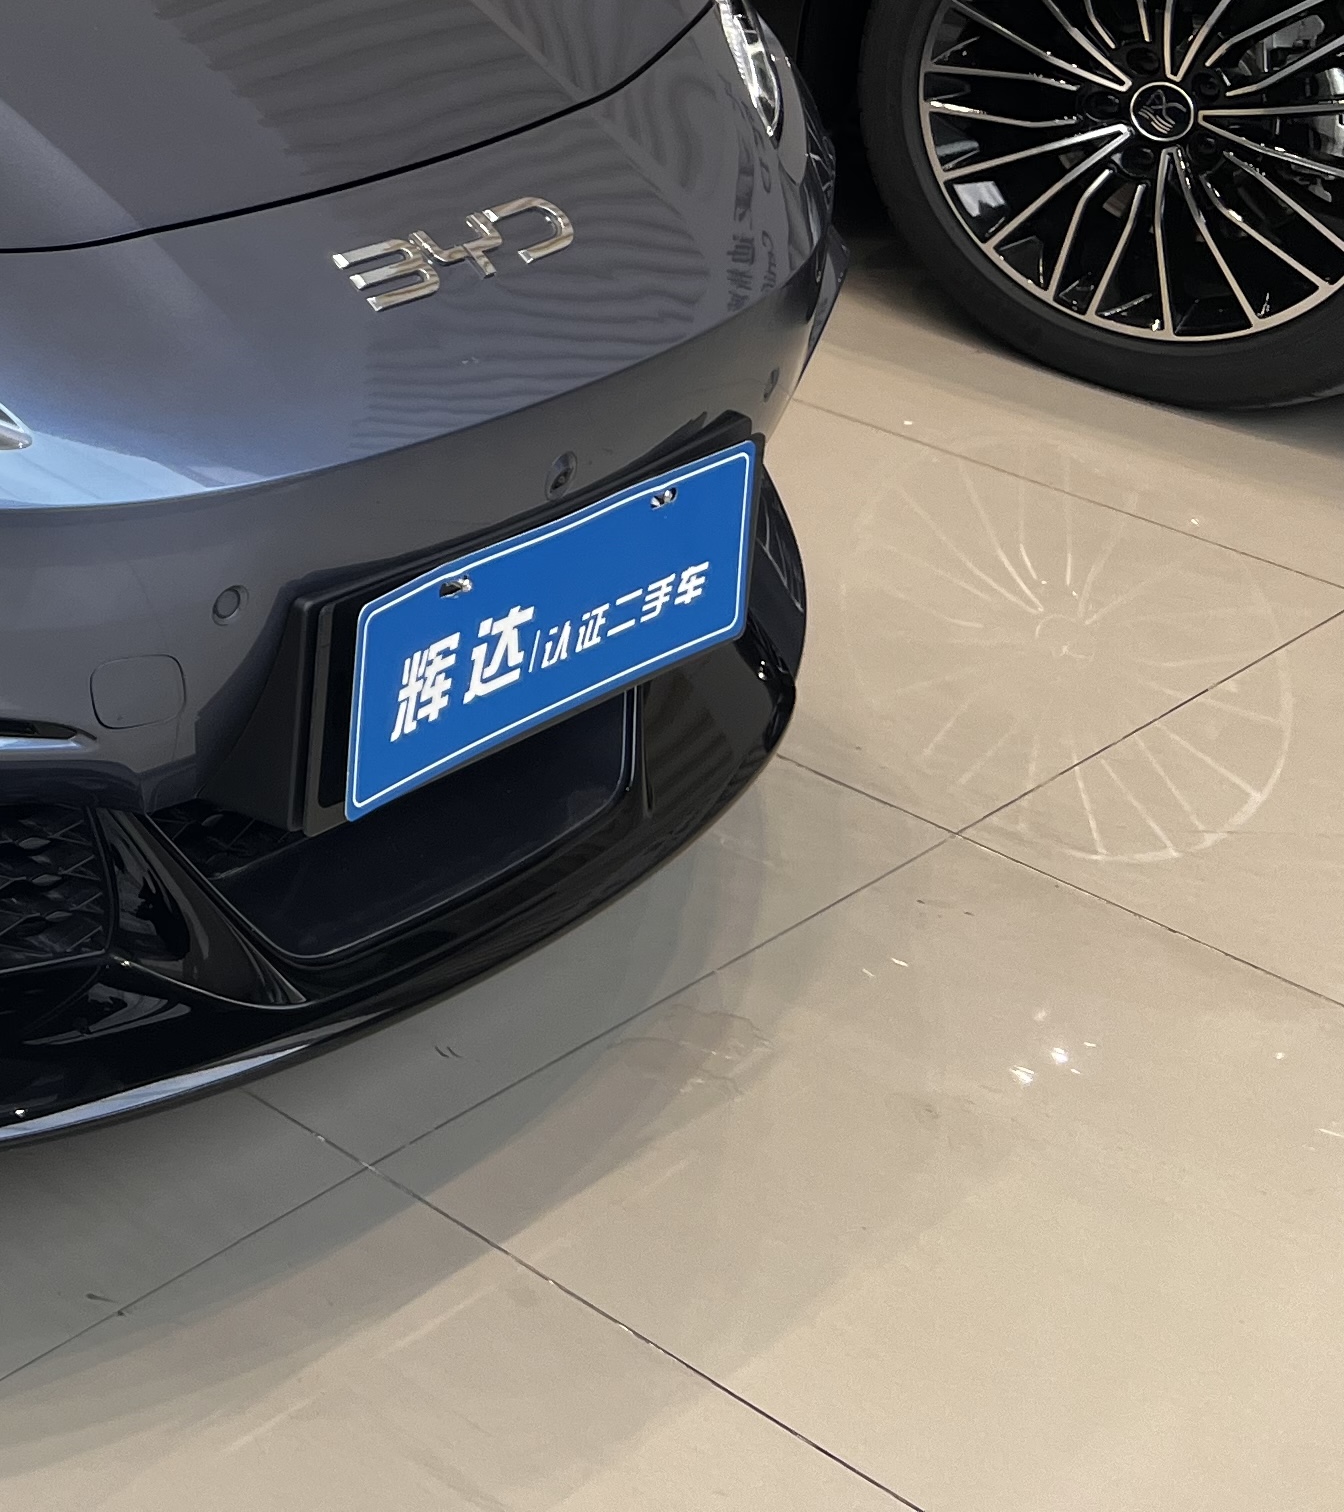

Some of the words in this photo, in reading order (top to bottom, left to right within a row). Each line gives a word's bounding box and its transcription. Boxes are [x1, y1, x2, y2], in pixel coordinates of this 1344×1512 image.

[332, 195, 575, 312] BYD
[390, 604, 537, 742] 辉达
[543, 560, 710, 670] 认证二手车
